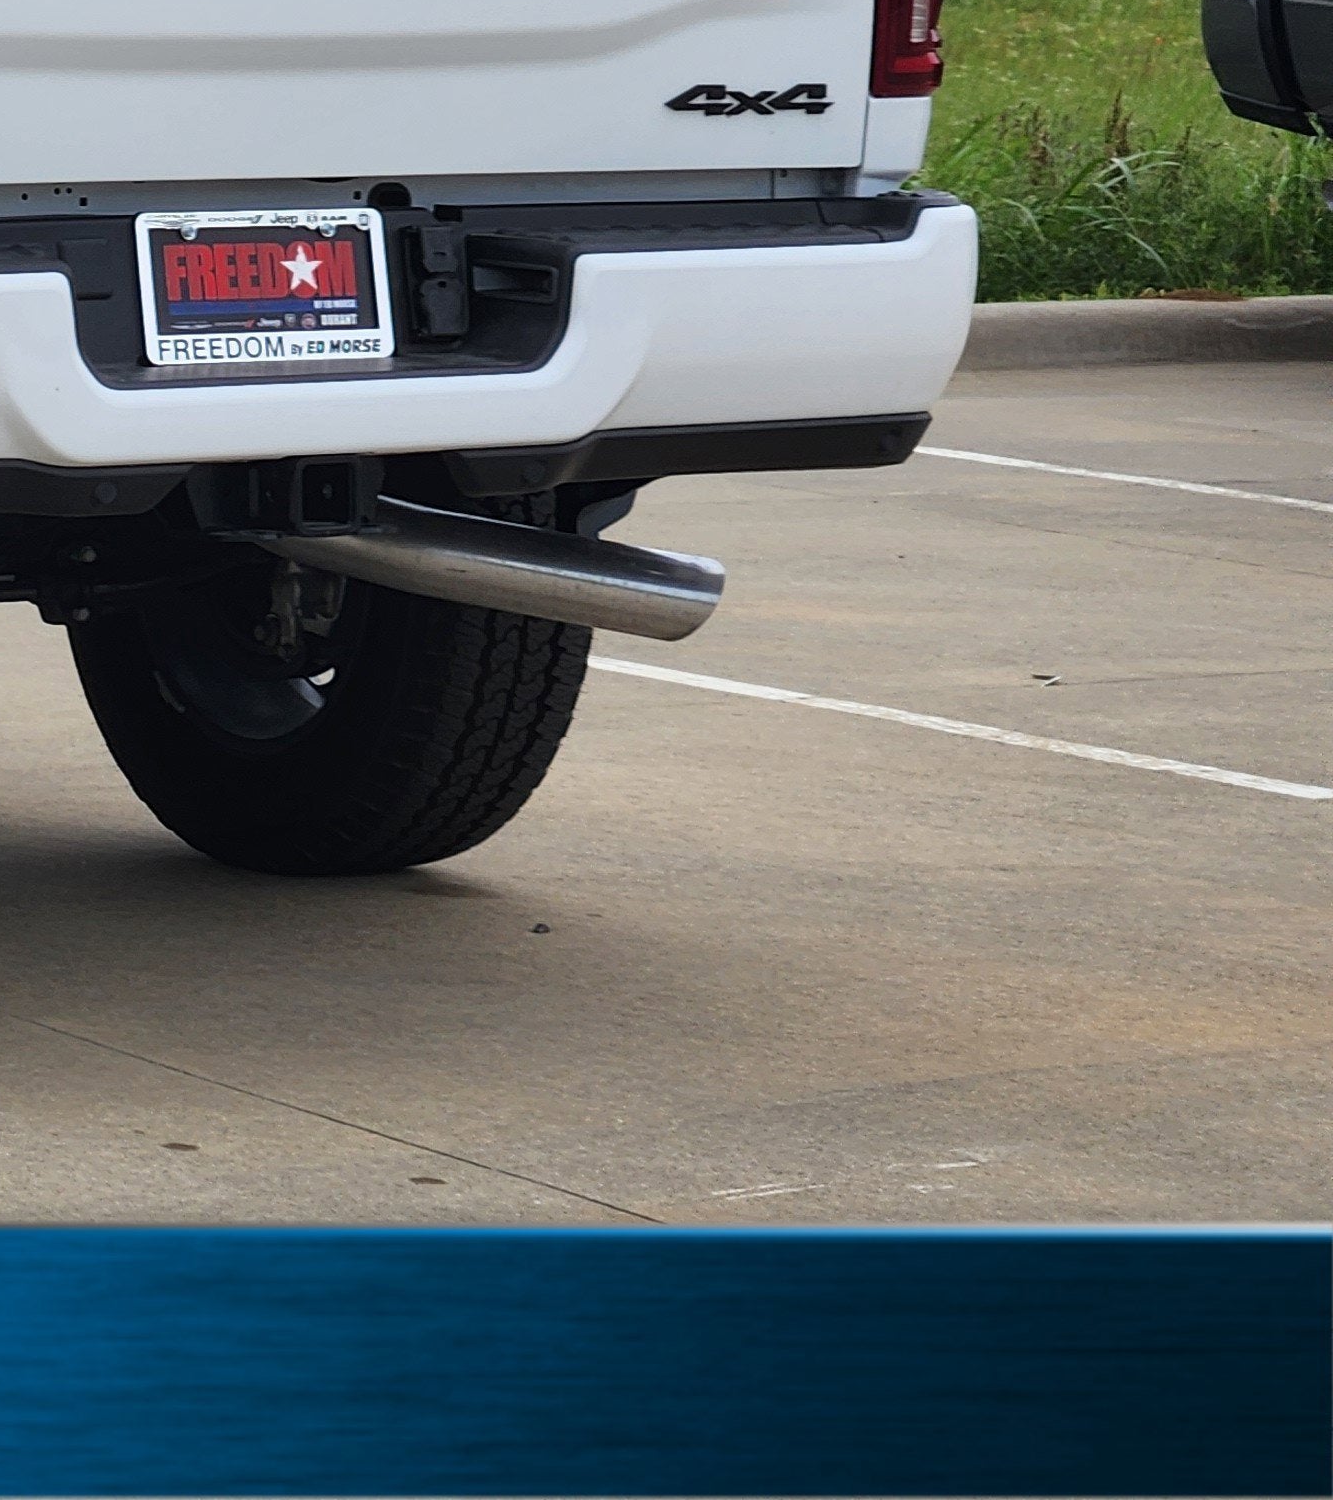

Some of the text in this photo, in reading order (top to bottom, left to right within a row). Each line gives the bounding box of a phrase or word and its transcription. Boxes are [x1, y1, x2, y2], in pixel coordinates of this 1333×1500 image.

[270, 213, 298, 225] Jeep
[163, 240, 358, 300] FREEDOM
[158, 336, 284, 361] FREEDOM
[307, 340, 325, 354] ED
[329, 338, 381, 353] MORSE
